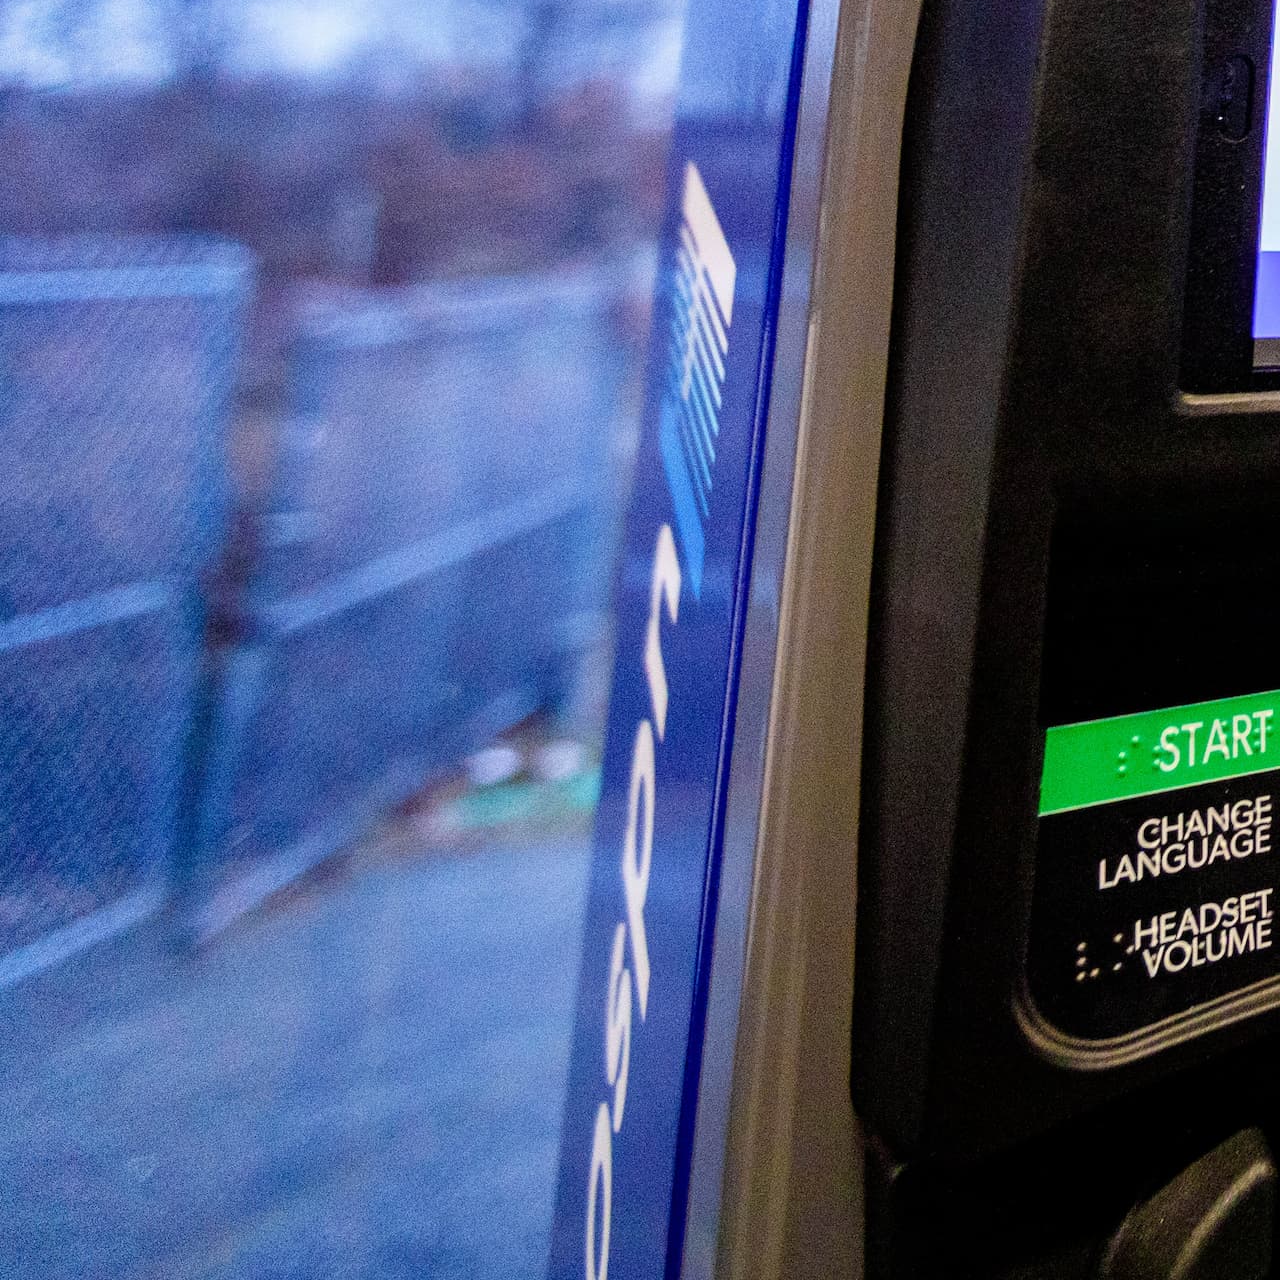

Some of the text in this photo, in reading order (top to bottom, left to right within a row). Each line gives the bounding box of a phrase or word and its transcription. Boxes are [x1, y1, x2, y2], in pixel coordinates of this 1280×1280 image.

[1159, 709, 1274, 773] START
[1137, 794, 1273, 849] CHANGE
[1099, 824, 1272, 890] LANGUAGE
[1134, 888, 1274, 951] HEADSET
[1142, 920, 1273, 979] VOLUME
